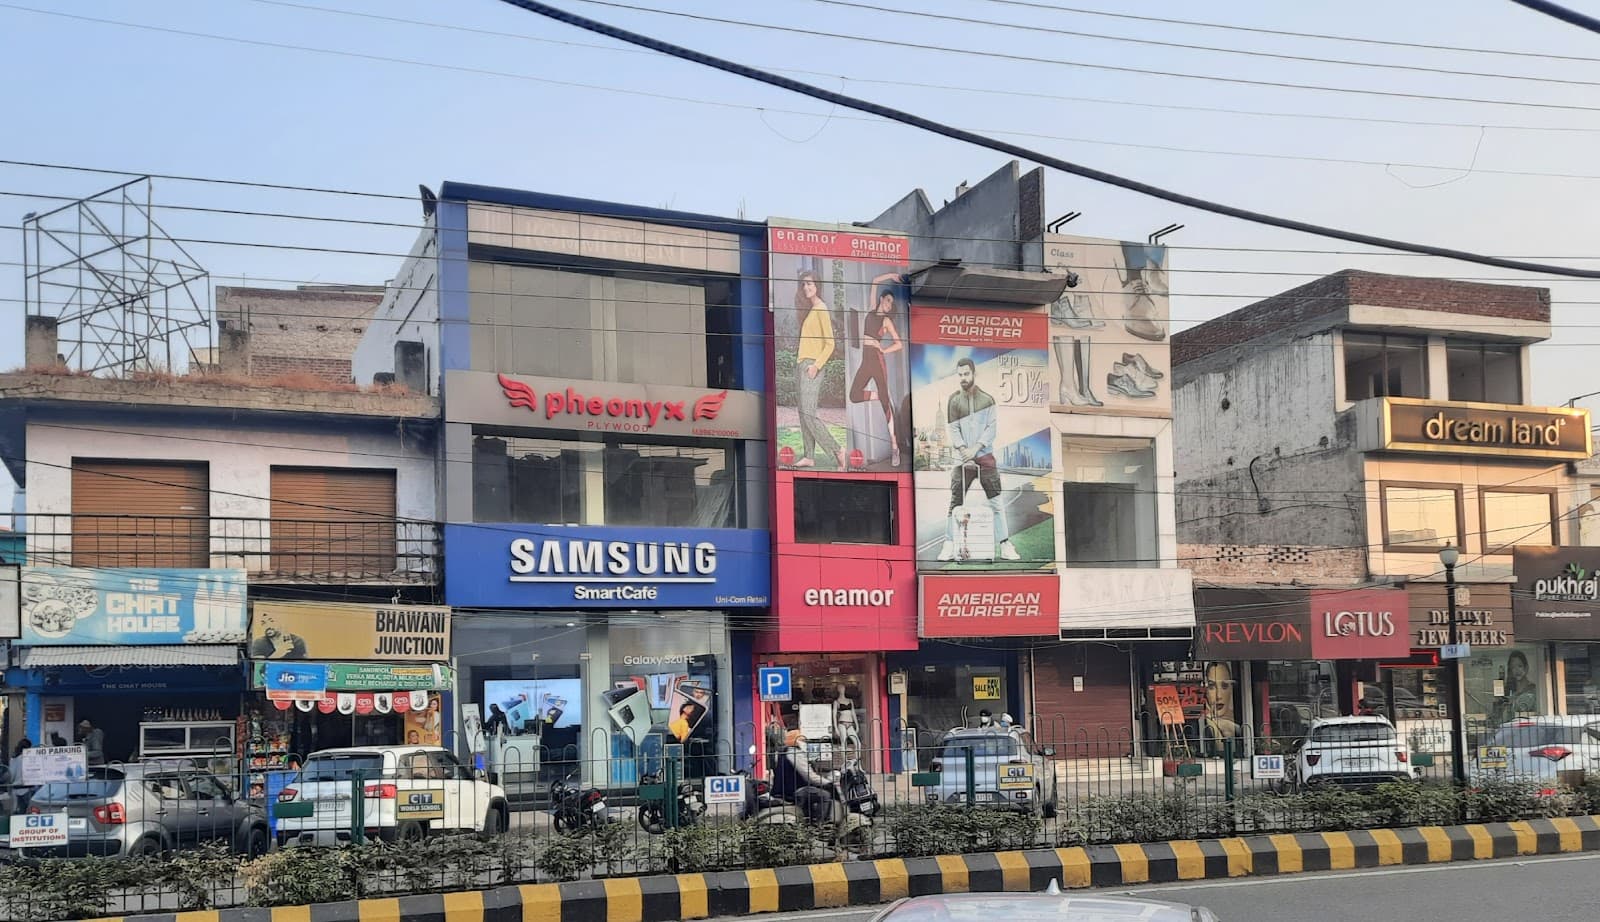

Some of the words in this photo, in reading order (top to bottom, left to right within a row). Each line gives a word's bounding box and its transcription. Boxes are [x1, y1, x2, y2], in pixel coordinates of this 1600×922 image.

[777, 230, 837, 244] enamor
[851, 238, 902, 253] enamor
[1050, 249, 1074, 258] Class
[940, 314, 1024, 327] AMERICAN
[938, 324, 1023, 338] TOURISTER
[546, 387, 686, 427] pheonyx
[587, 421, 649, 432] PLYWOOD
[1425, 411, 1504, 443] dream
[1511, 417, 1560, 446] land
[509, 538, 717, 574] SAMSUNG
[129, 579, 159, 591] THE
[574, 585, 657, 600] SmartCafé
[1535, 575, 1598, 600] pukhraj
[106, 593, 182, 614] CHAT
[747, 596, 767, 604] Retail
[804, 587, 894, 607] enamor
[938, 592, 1041, 605] AMERICAN
[937, 605, 1040, 617] TOURISTER
[107, 616, 181, 633] HOUSE
[376, 611, 445, 633] BHAWANI
[1324, 611, 1396, 637] LOTUS
[1205, 622, 1302, 643] REVLON
[374, 636, 444, 655] JUNCTION
[623, 655, 662, 667] Galaxy
[278, 672, 295, 682] Jio
[767, 673, 784, 695] P
[1156, 695, 1178, 705] 50%
[12, 834, 66, 842] INSTITUTIONS
